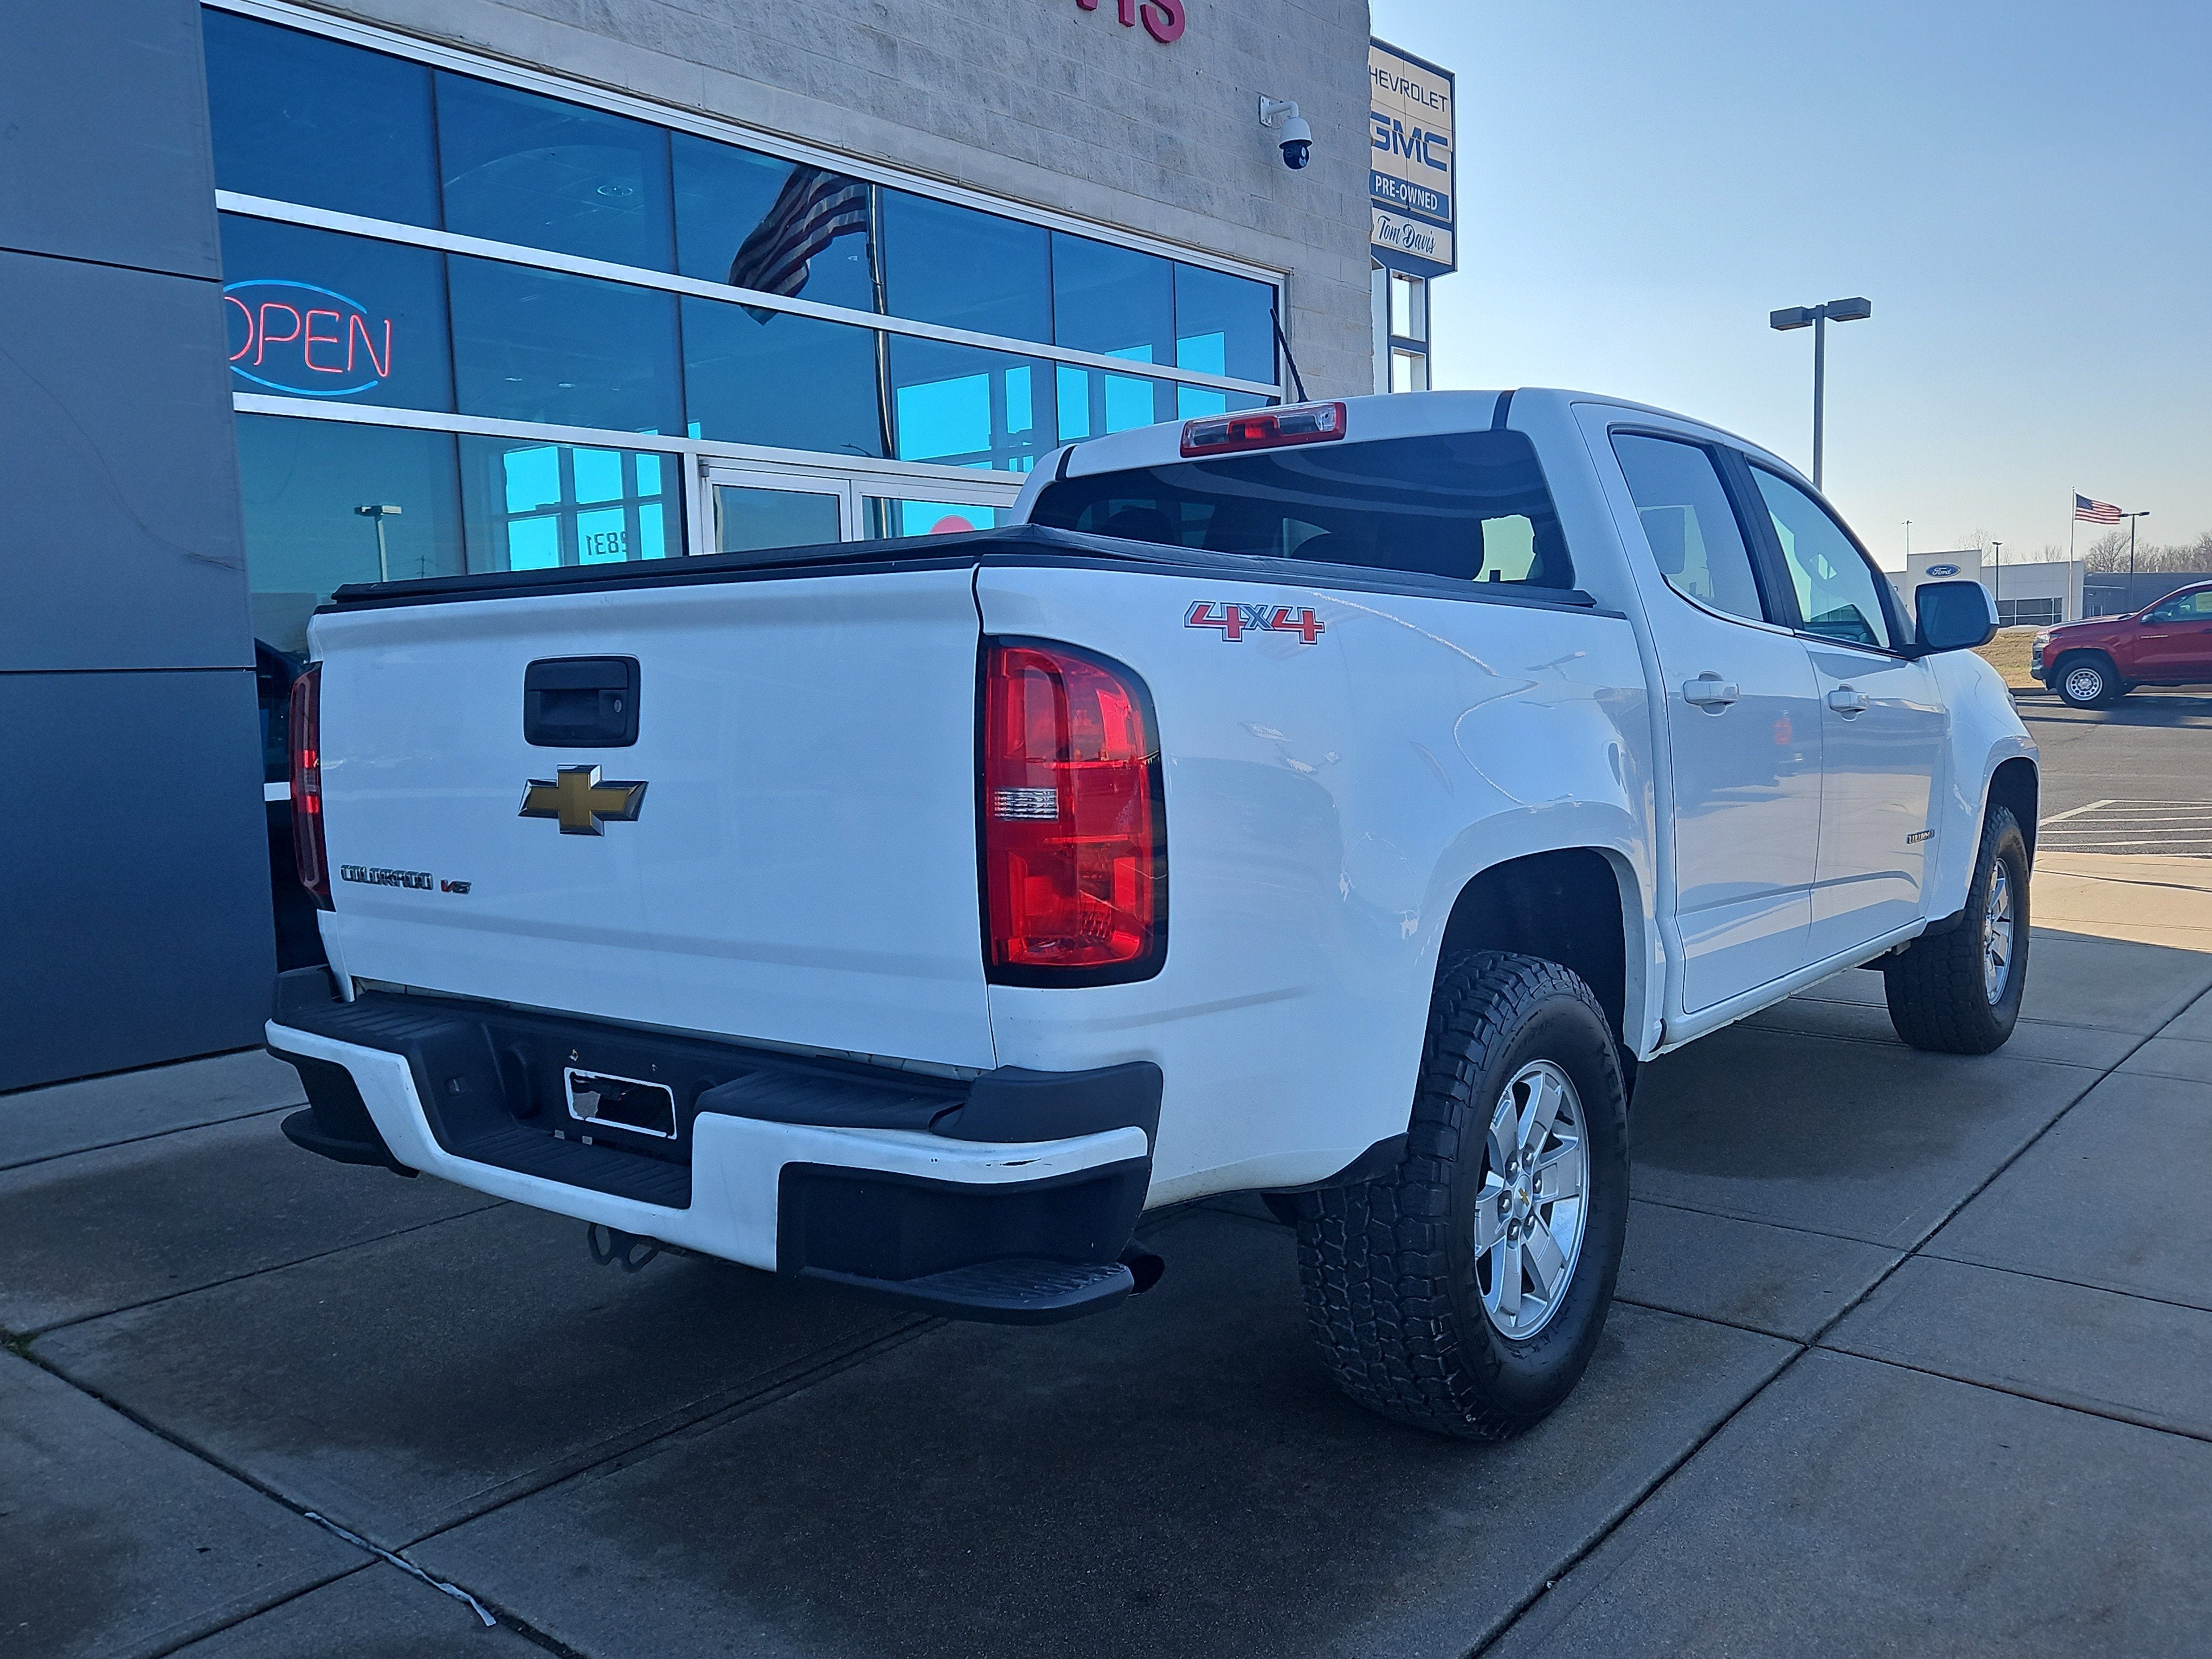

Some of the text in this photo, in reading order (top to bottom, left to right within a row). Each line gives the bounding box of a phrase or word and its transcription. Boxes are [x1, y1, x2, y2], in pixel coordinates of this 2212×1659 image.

[1369, 65, 1448, 112] HEVROLET
[1371, 111, 1448, 172] GMC
[1375, 174, 1438, 211] PRE-OWNED
[1377, 215, 1436, 255] Tom Davis
[1932, 567, 1952, 575] Ford
[440, 879, 472, 895] V6
